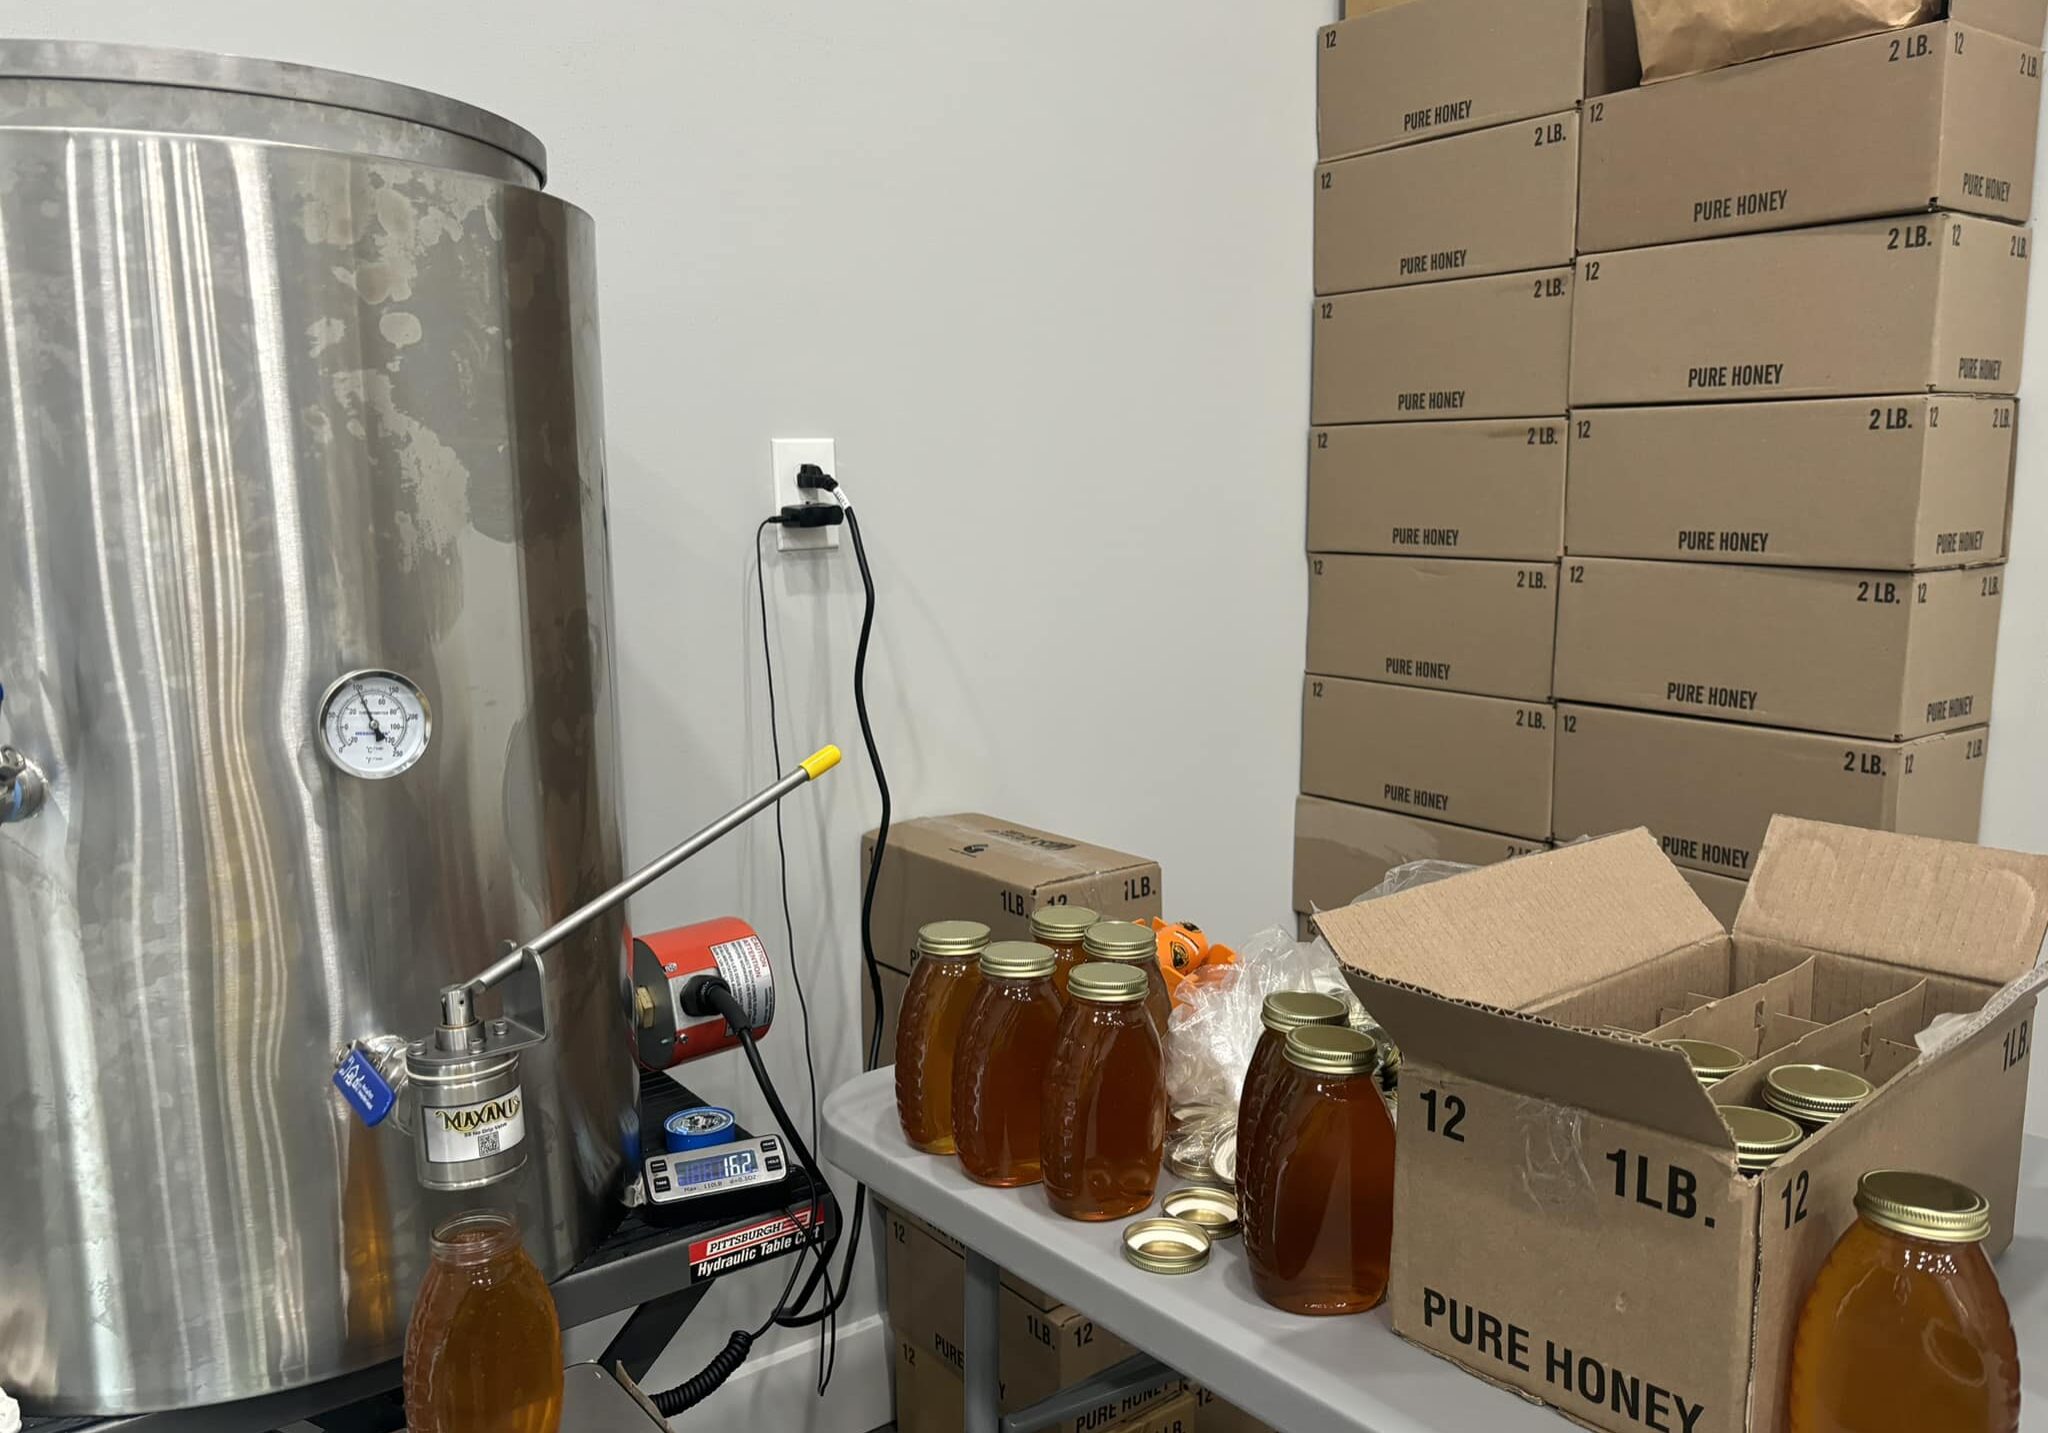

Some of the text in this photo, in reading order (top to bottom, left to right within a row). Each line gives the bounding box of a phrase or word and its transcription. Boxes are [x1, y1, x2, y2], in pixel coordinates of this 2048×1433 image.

[1326, 31, 1336, 48] 12
[1889, 35, 1932, 61] 2 LB.
[1955, 32, 1964, 54] 12
[2020, 53, 2025, 74] 2
[1405, 100, 1471, 131] PURE HONEY
[1591, 103, 1603, 122] 12
[1535, 124, 1566, 146] 2 LB.
[1322, 172, 1331, 189] 12
[1963, 173, 2010, 201] PURE HONEY
[1694, 190, 1787, 222] PURE HONEY
[1888, 226, 1931, 249] 2 LB.
[1953, 224, 1961, 246] 12
[2011, 236, 2016, 256] 2
[1400, 250, 1466, 275] PURE HONEY
[1586, 262, 1599, 281] 12
[1534, 278, 1564, 298] 2 LB.
[1322, 303, 1332, 319] 12
[1689, 364, 1783, 387] PURE HONEY
[1959, 358, 2001, 380] PURE HONEY
[1398, 391, 1464, 410] PURE HONEY
[1869, 408, 1912, 430] 2 LB.
[1930, 407, 1938, 427] 12
[1993, 408, 1998, 428] 2
[1318, 433, 1327, 448] 12
[1528, 427, 1557, 444] 2 LB.
[1578, 421, 1590, 438] 12
[1393, 528, 1458, 545] PURE HONEY
[1679, 531, 1768, 552] PURE HONEY
[1936, 531, 1984, 553] PURE HONEY
[1314, 560, 1322, 575] 12
[1571, 566, 1584, 583] 12
[1517, 571, 1546, 589] 2 LB.
[1981, 577, 1987, 596] 2
[1857, 581, 1900, 604] 2 LB.
[1918, 583, 1926, 603] 12
[1386, 658, 1450, 680] PURE HONEY
[1313, 682, 1323, 697] 12
[1667, 683, 1757, 710] PURE HONEY
[1516, 710, 1545, 729] 2 LB.
[1927, 696, 1973, 722] PURE HONEY
[1564, 715, 1576, 732] 12
[1966, 741, 1972, 759] 2
[1844, 752, 1886, 776] 2 LB.
[1905, 754, 1913, 774] 12
[1385, 784, 1448, 810] PURE HONEY
[1662, 836, 1749, 868] PURE HONEY
[1124, 876, 1156, 901] 1LB.
[1001, 890, 1029, 919] 1LB.
[743, 939, 762, 978] ATTENTION
[751, 937, 767, 967] CAUTION
[2004, 1021, 2028, 1071] 1LB.
[1420, 1089, 1465, 1142] 12
[1607, 1149, 1714, 1228] 1LB.
[1782, 1170, 1809, 1229] 12
[709, 1222, 782, 1253] PITTSBURGH
[893, 1221, 905, 1244] 12
[697, 1226, 820, 1277] Hydraulic Table Ct
[1027, 1314, 1056, 1350] 1LB.
[1074, 1322, 1093, 1347] 12
[903, 1342, 916, 1366] 12
[935, 1333, 964, 1370] PURE
[1424, 1288, 1704, 1433] PURE HONEY
[1076, 1403, 1117, 1433] PURE
